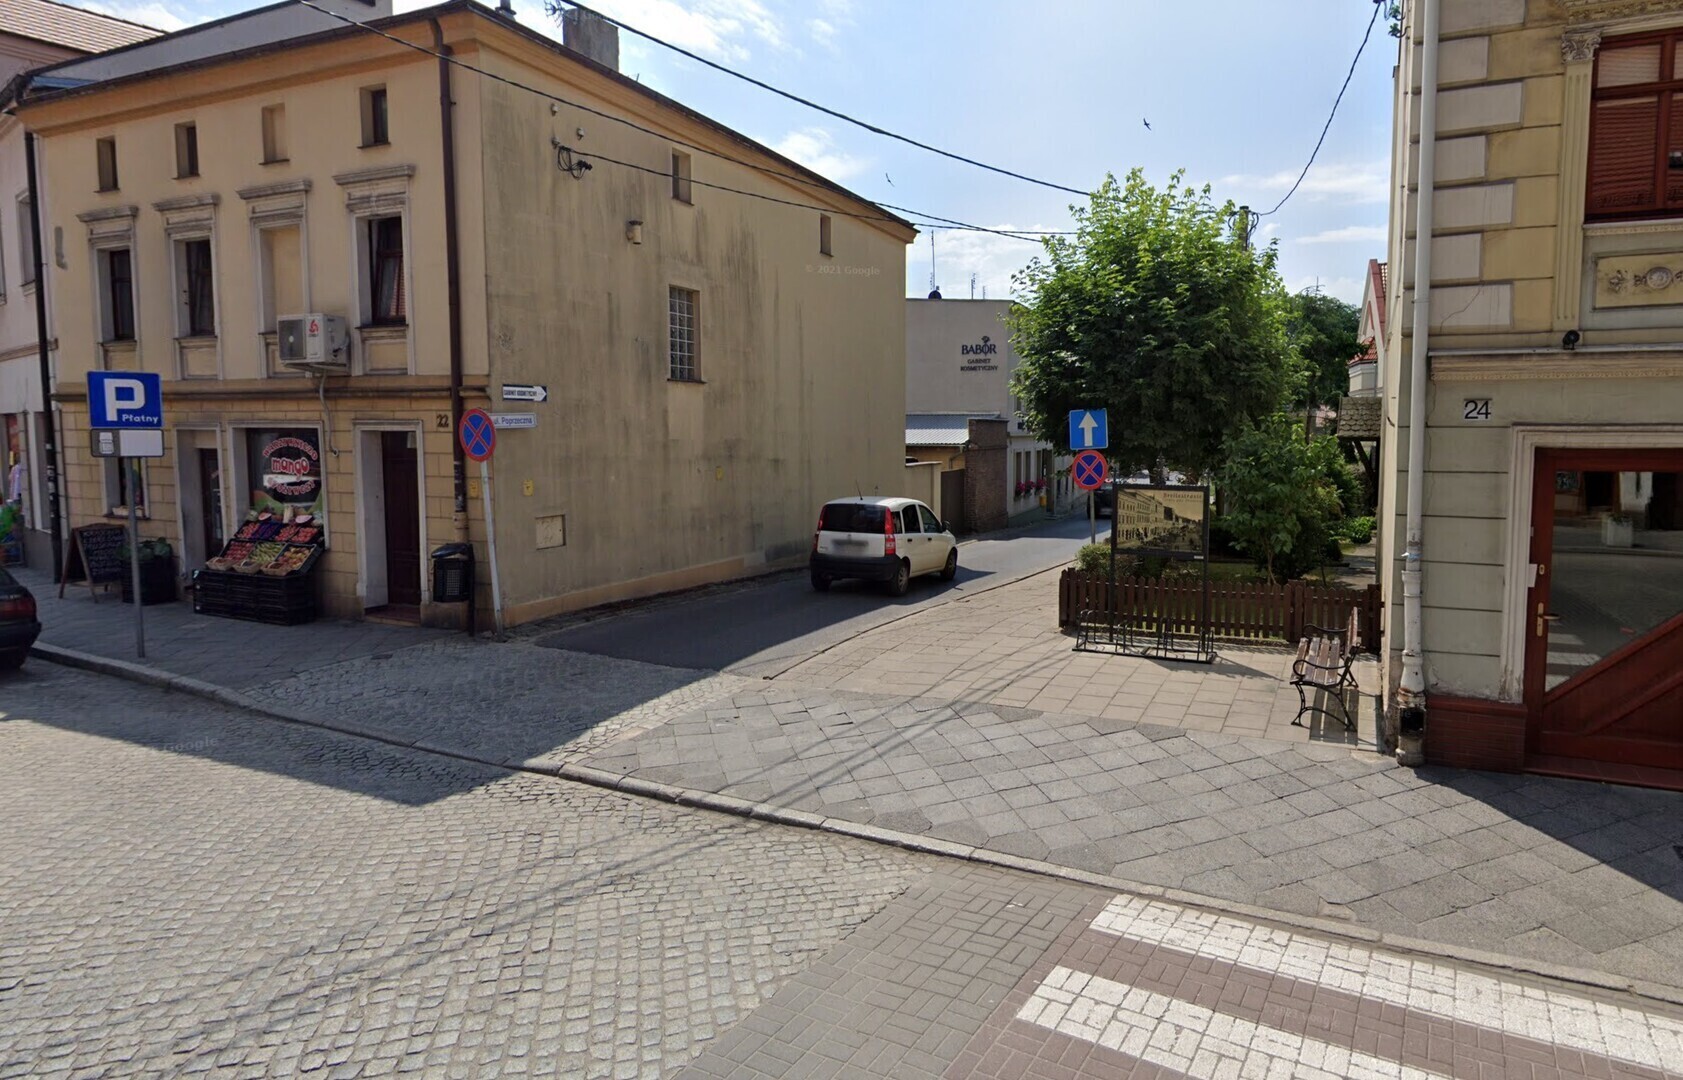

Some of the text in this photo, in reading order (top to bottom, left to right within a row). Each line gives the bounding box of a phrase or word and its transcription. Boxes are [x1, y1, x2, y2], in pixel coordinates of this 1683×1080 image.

[961, 343, 997, 356] BABOR
[103, 378, 146, 422] P
[1464, 400, 1492, 420] 24
[121, 413, 159, 425] Płatny
[436, 414, 449, 428] 22
[501, 416, 533, 427] Poprzeczna
[271, 457, 310, 482] mango
